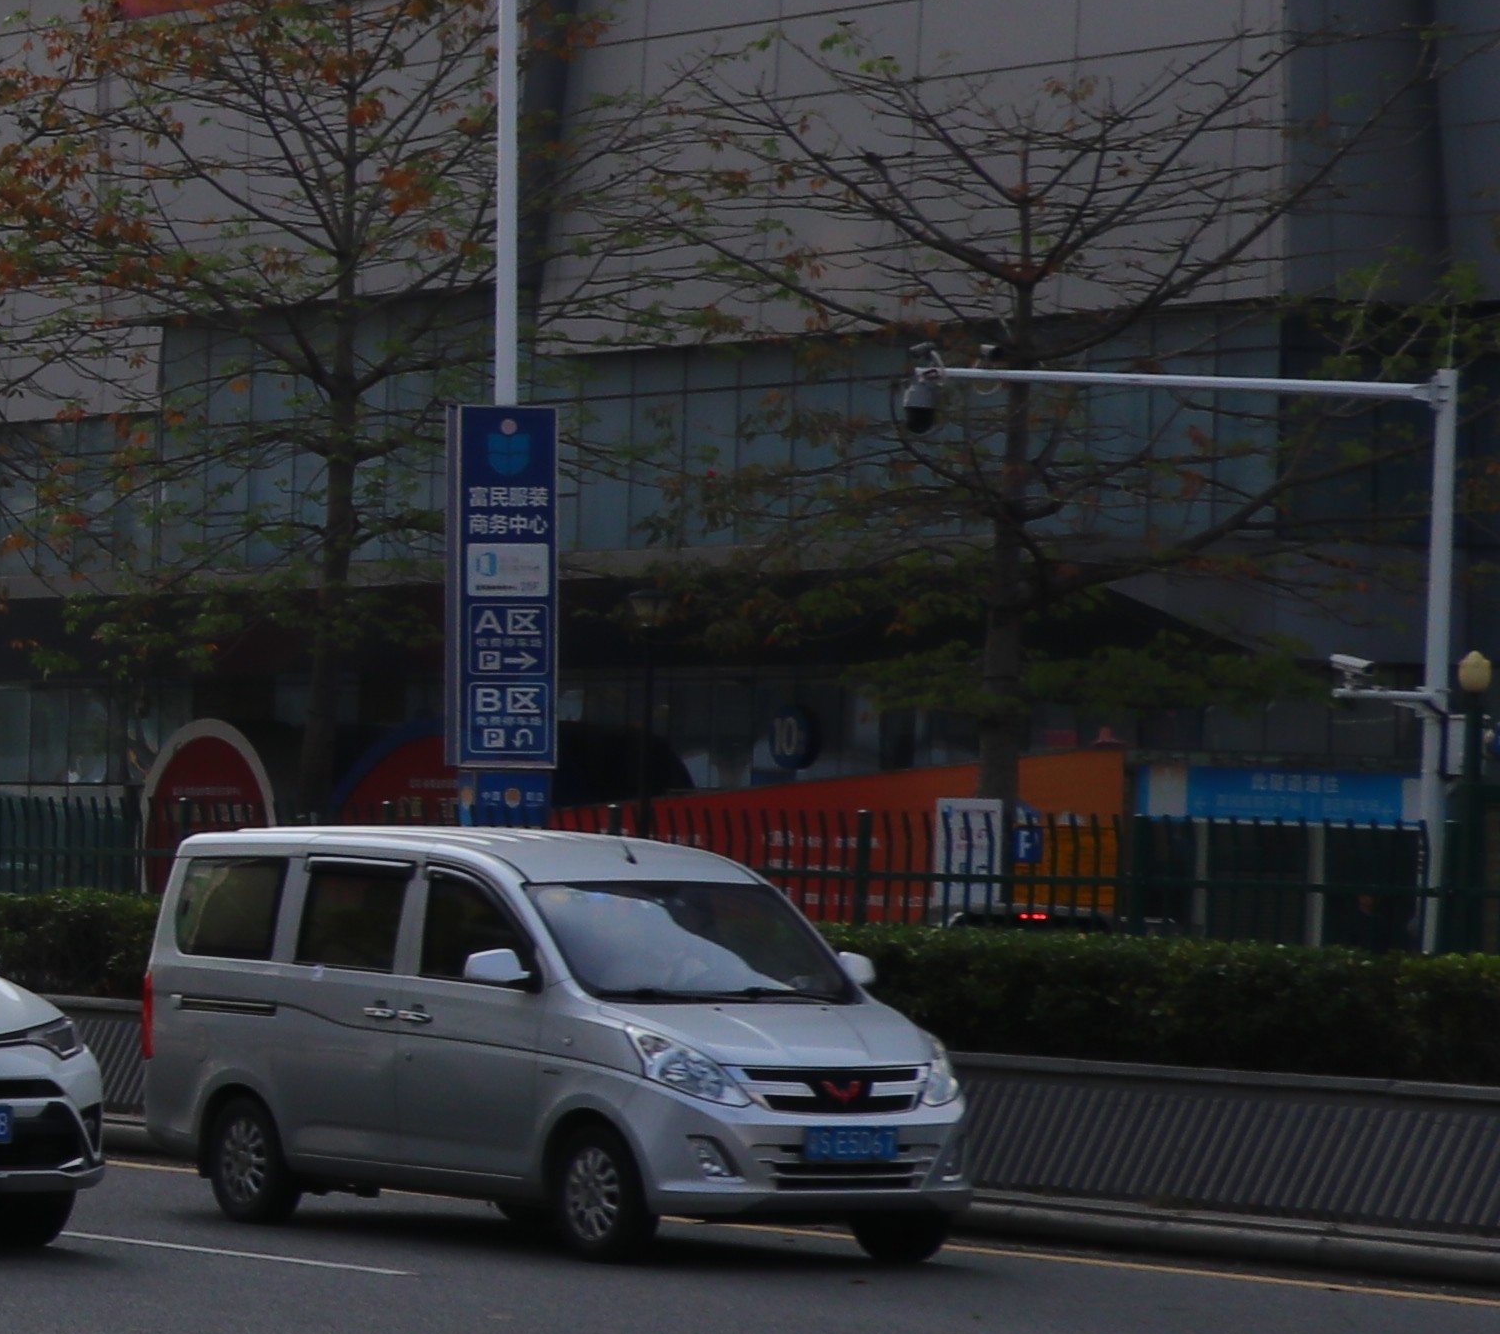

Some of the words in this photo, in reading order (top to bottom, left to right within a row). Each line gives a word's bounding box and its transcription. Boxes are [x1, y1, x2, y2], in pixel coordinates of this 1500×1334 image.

[469, 487, 549, 508] 富民服装
[469, 514, 548, 536] 商务中心
[474, 609, 541, 635] A区
[476, 688, 541, 713] B区
